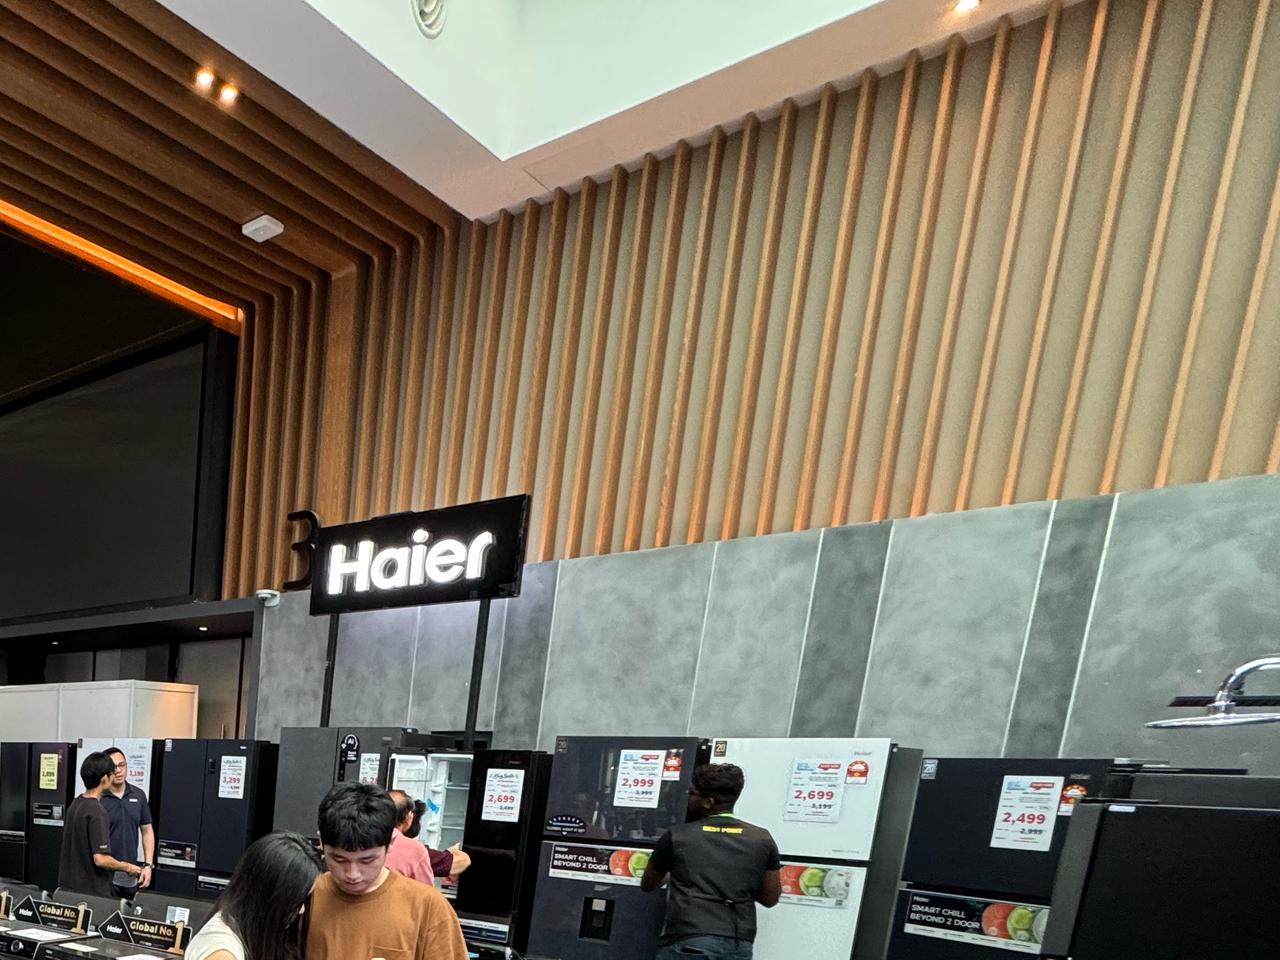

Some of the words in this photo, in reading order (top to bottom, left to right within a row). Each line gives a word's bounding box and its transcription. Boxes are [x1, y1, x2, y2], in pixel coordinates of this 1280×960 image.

[327, 528, 495, 595] Haier
[222, 777, 241, 785] 3,299
[621, 778, 654, 788] 2,999
[488, 794, 515, 803] 2,699
[794, 790, 834, 801] 2,699
[1002, 812, 1046, 825] 2,499
[554, 853, 577, 861] SMART
[578, 855, 597, 863] CHILL
[553, 860, 581, 869] BEYOND
[587, 863, 608, 871] DOOR
[18, 908, 34, 917] Haier
[39, 903, 64, 917] Global
[65, 906, 77, 919] No.
[911, 904, 940, 914] SMART
[941, 908, 966, 918] CHILL
[70, 902, 88, 935] 1
[910, 912, 945, 924] BEYOND
[946, 917, 952, 925] 2
[953, 918, 980, 929] DOOR
[106, 924, 122, 934] Haier
[130, 921, 159, 934] Global
[159, 926, 175, 937] No.
[167, 920, 185, 955] 1
